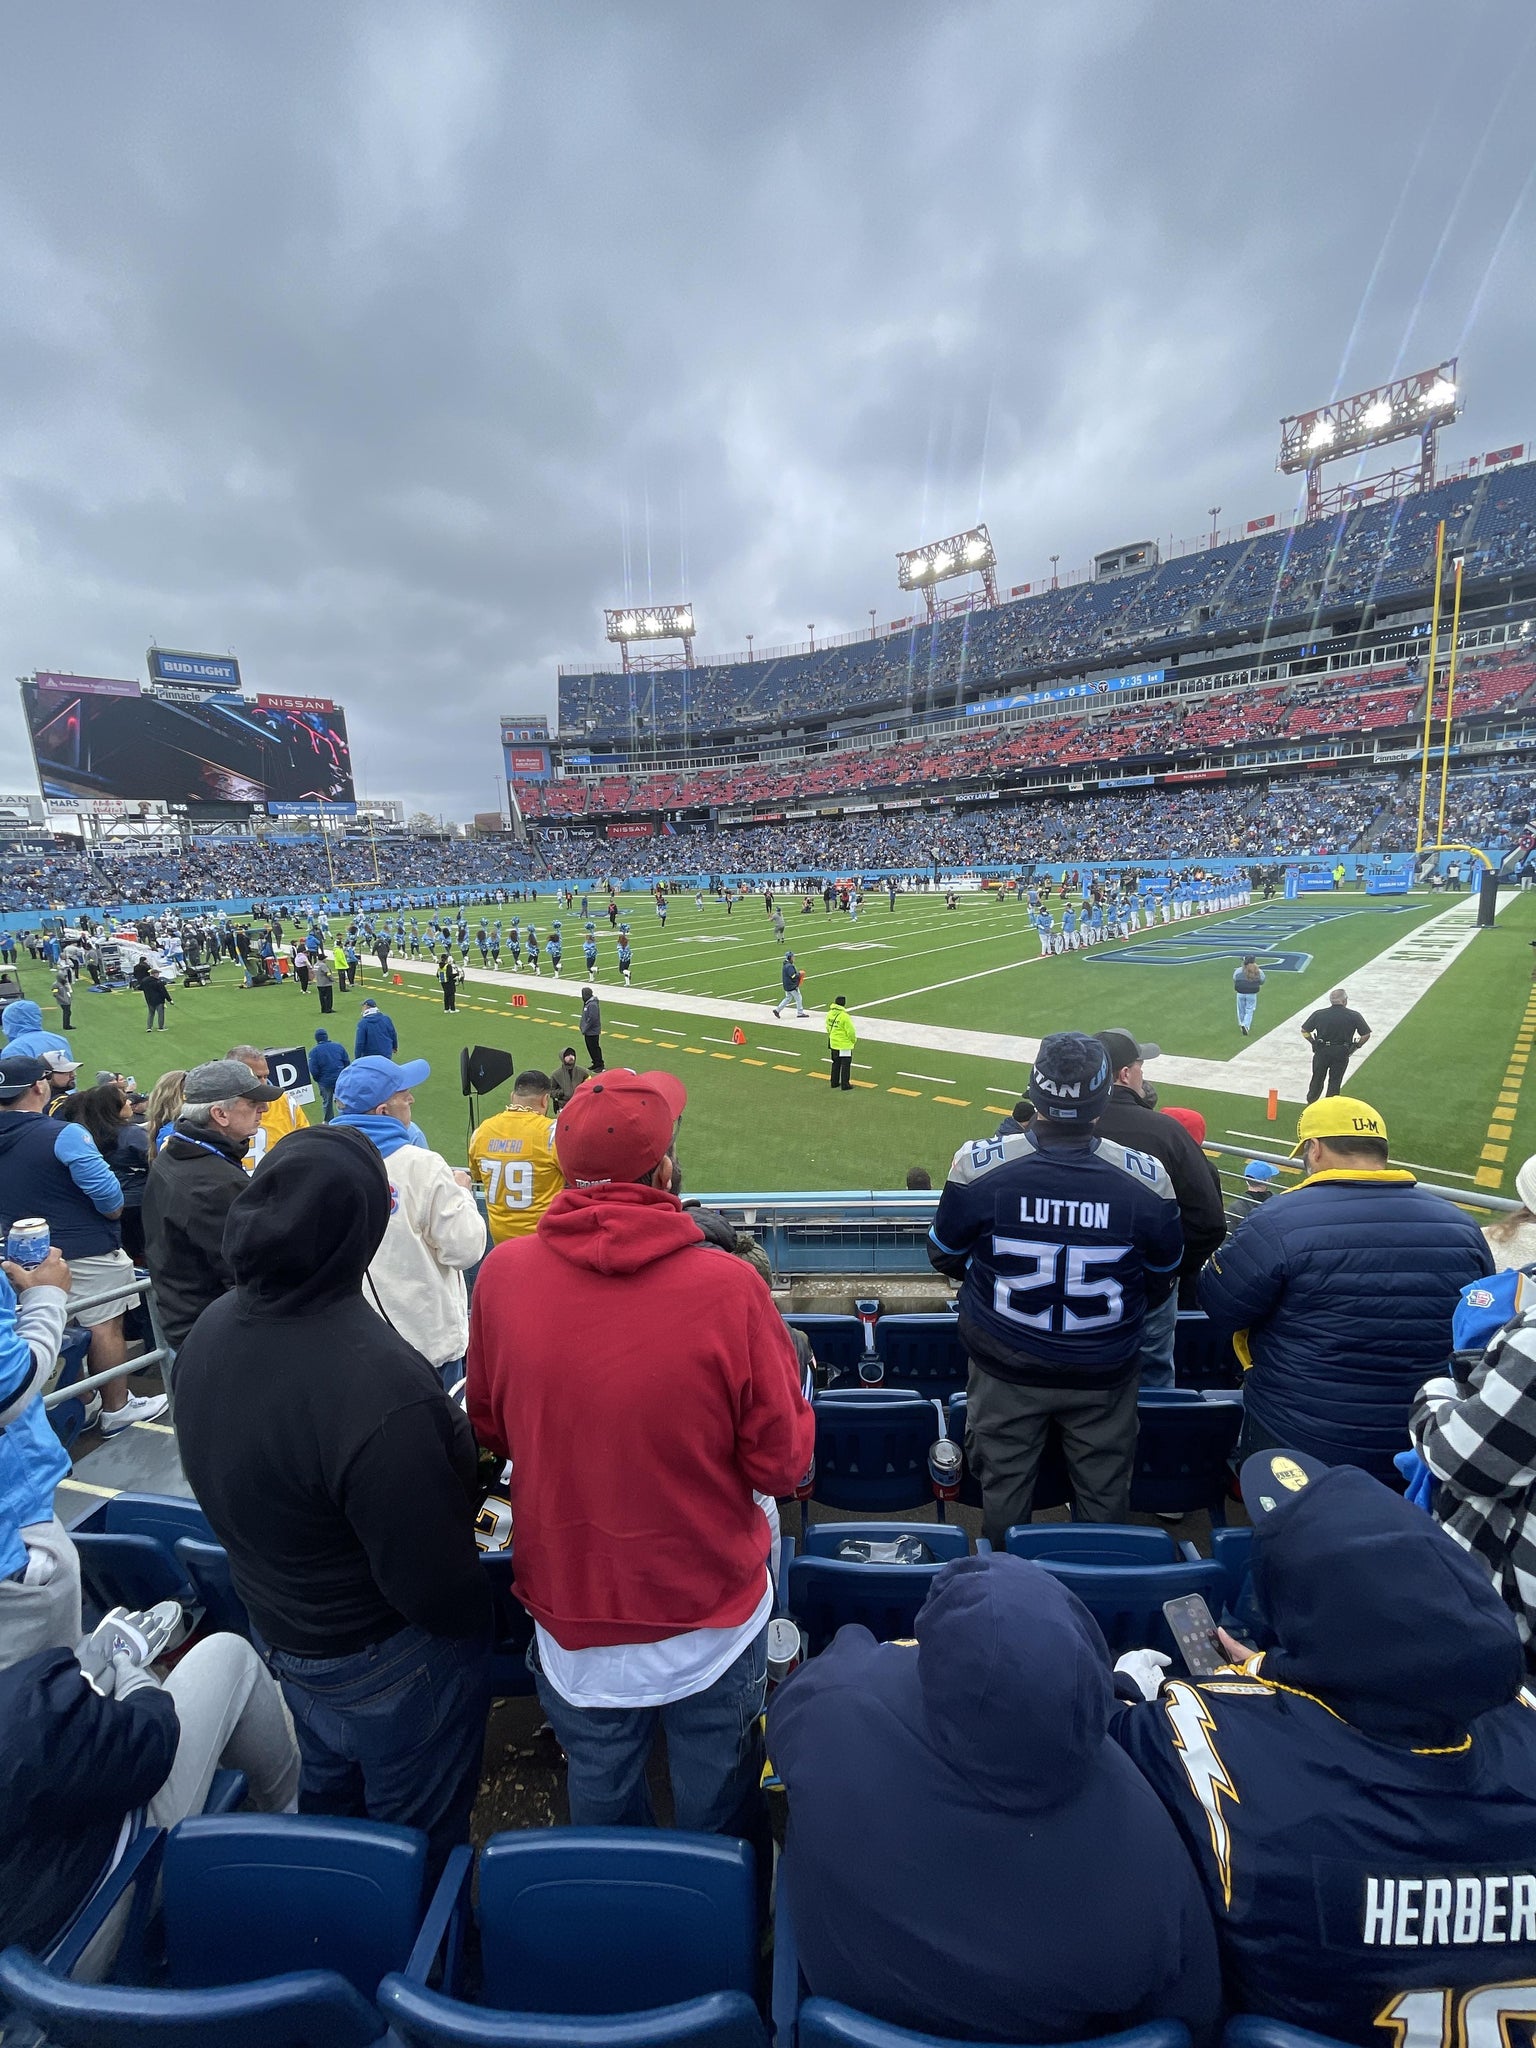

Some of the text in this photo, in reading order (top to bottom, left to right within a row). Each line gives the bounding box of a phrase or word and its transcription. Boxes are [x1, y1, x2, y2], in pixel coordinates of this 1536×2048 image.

[164, 661, 231, 678] BUD LIGHT
[1119, 674, 1158, 687] 9:35 1st
[158, 689, 201, 702] Pinnacle
[1043, 692, 1050, 701] 0
[1069, 688, 1075, 696] 0
[268, 697, 326, 710] NISSAN
[1374, 752, 1408, 763] Pinnacle
[1116, 777, 1146, 787] Gallagher
[955, 794, 975, 802] ROCKY
[612, 825, 648, 833] NISSAN
[1387, 950, 1448, 962] US
[513, 995, 524, 1006] 10
[275, 1063, 298, 1088] D
[1351, 1117, 1380, 1135] U-M
[486, 1138, 524, 1154] ROMERO
[480, 1158, 535, 1210] 79
[1019, 1195, 1110, 1230] LUTTON
[992, 1234, 1135, 1333] 25
